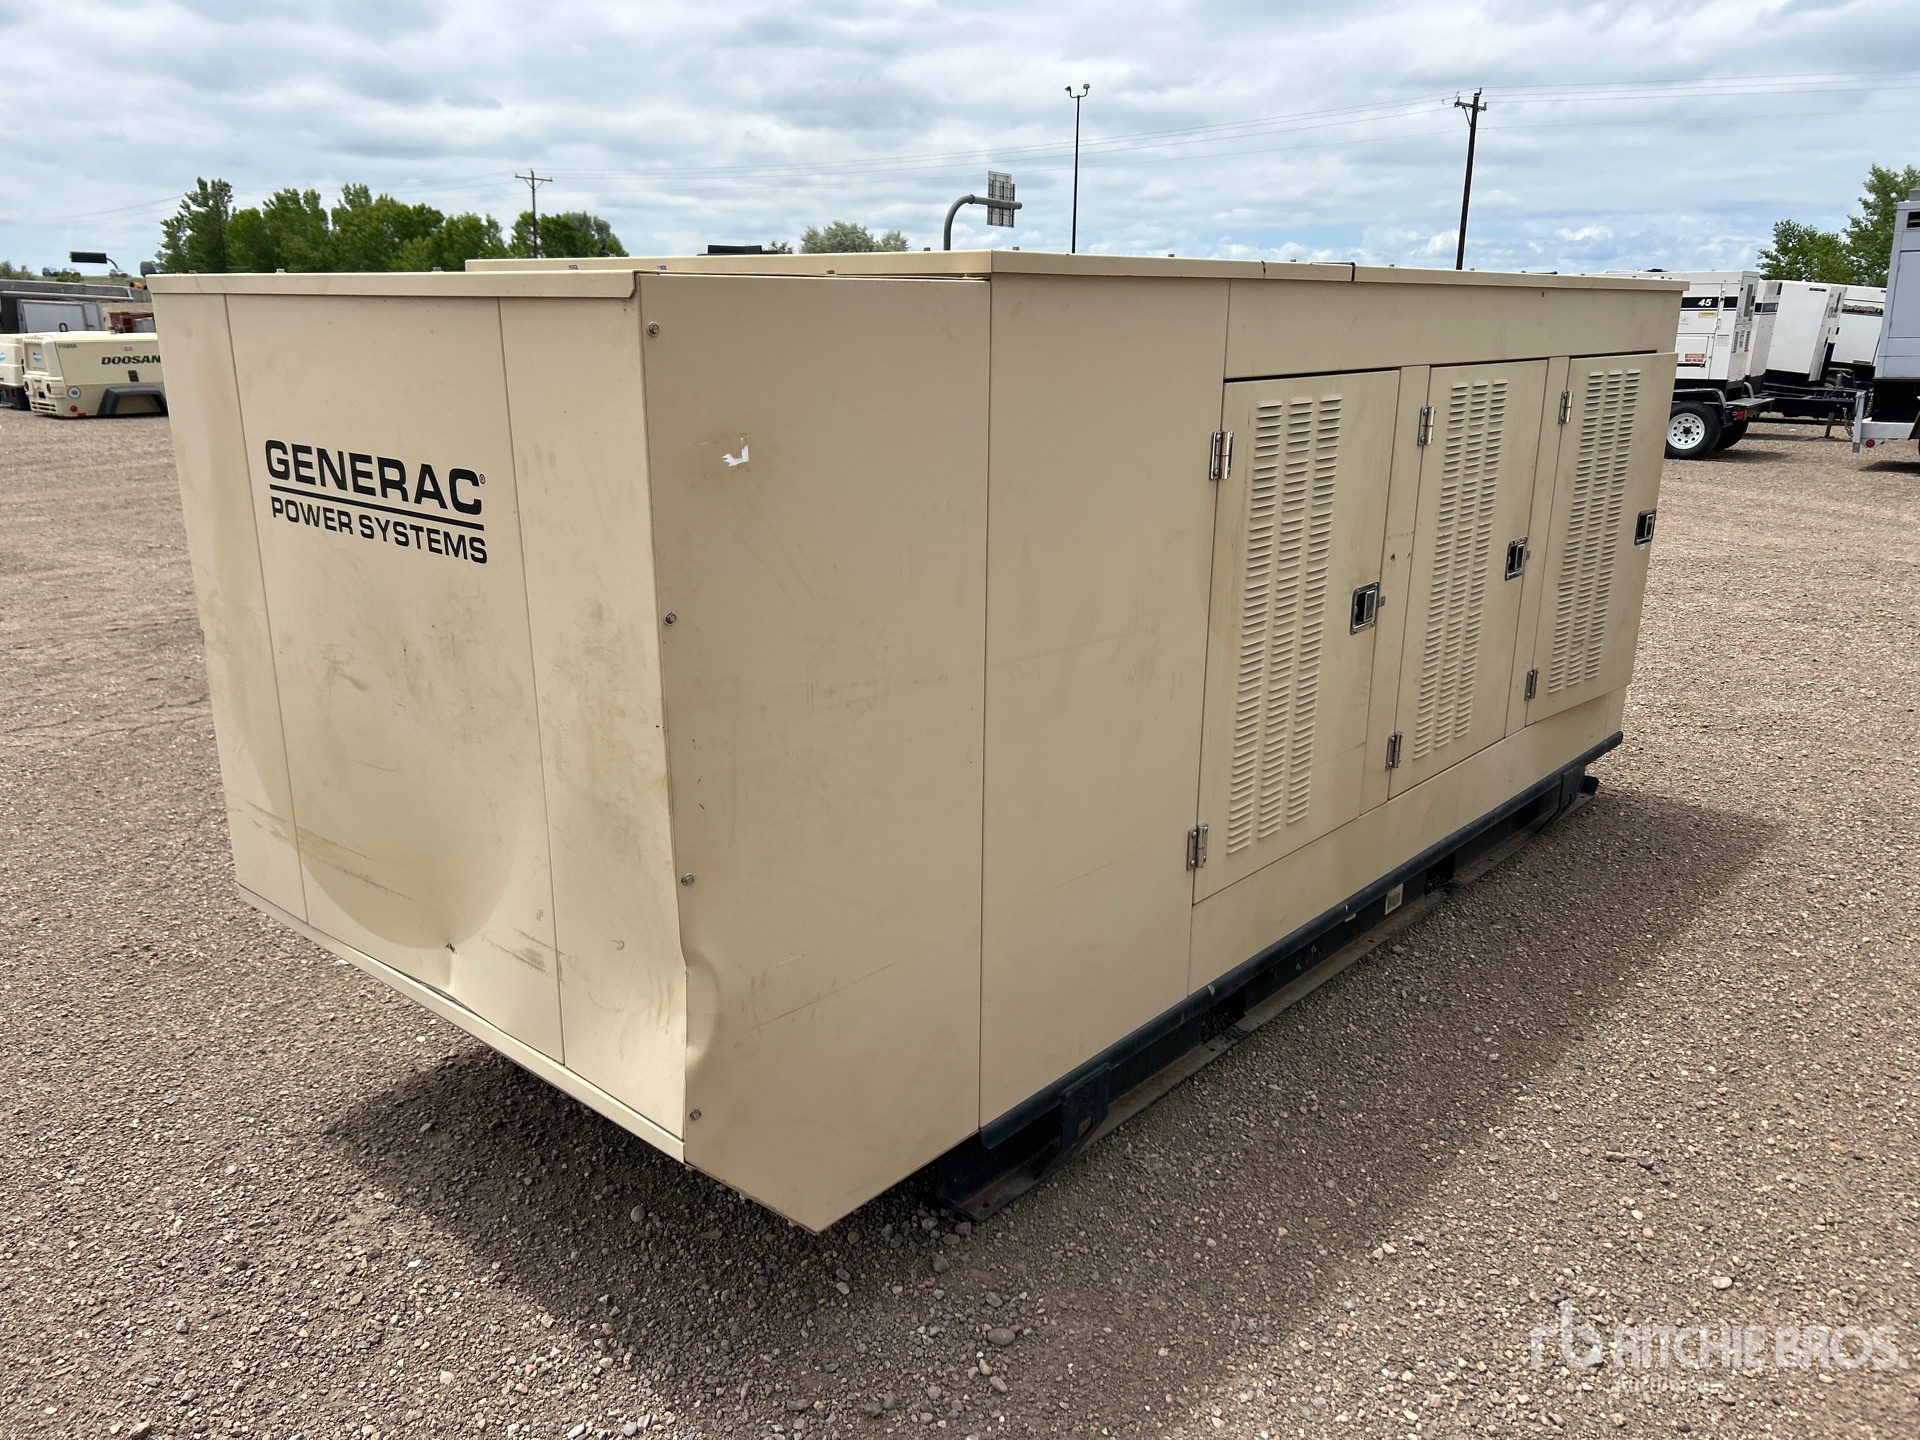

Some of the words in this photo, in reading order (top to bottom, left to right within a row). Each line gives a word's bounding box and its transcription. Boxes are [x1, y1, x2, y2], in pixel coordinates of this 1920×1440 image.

[1698, 298, 1712, 306] 45
[101, 355, 161, 365] DOOSAN
[264, 439, 482, 516] GENERAC
[270, 496, 354, 535] POWER
[358, 514, 488, 565] SYSTEMS
